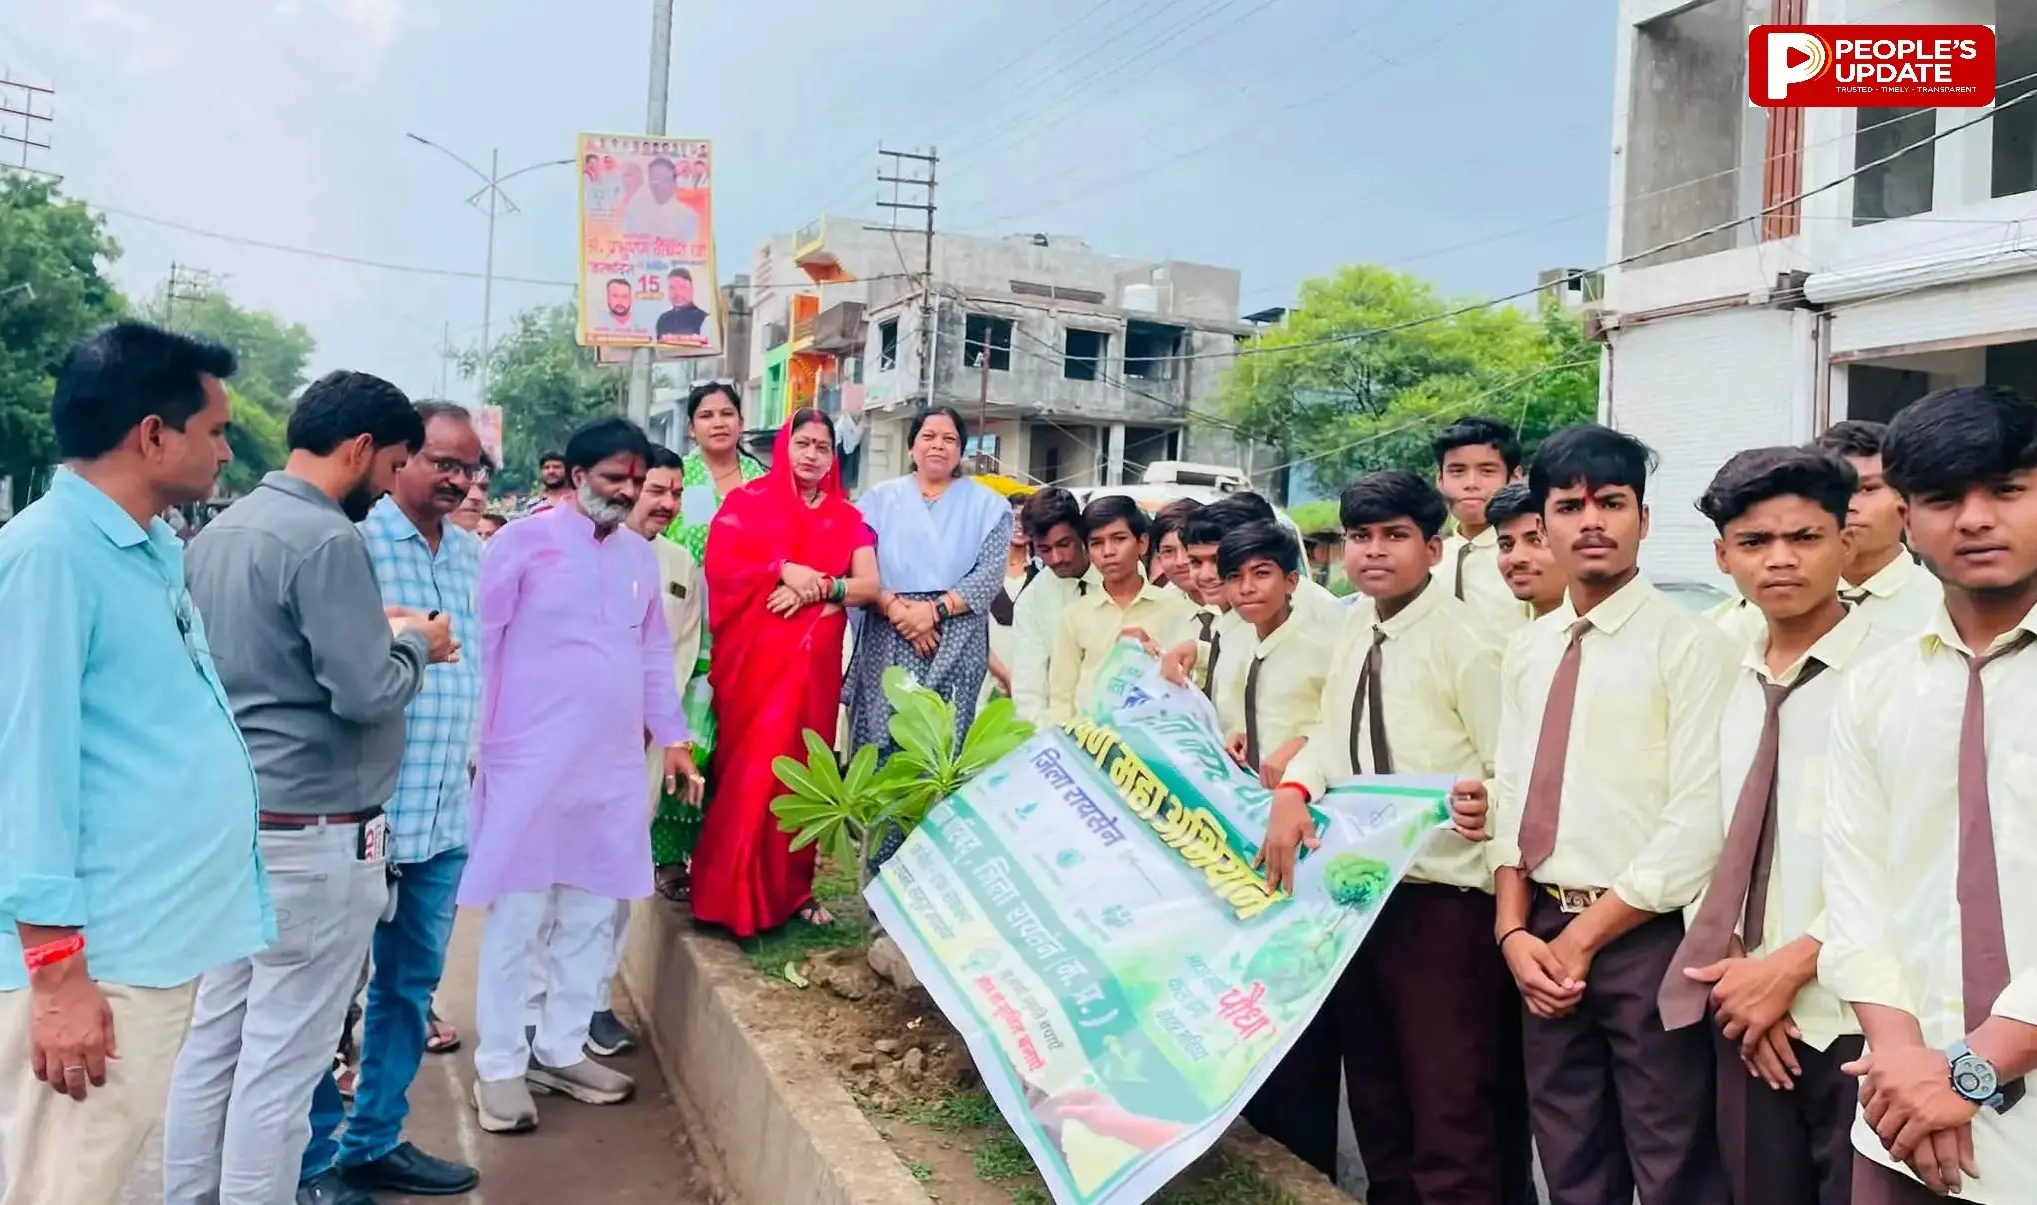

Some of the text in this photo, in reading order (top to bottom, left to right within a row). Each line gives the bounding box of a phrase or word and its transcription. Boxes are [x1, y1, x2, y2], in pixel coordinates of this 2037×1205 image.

[638, 275, 660, 293] 15
[1029, 747, 1077, 790] जिला
[1063, 785, 1128, 847] रायसेन
[1218, 979, 1271, 1041] पौधा
